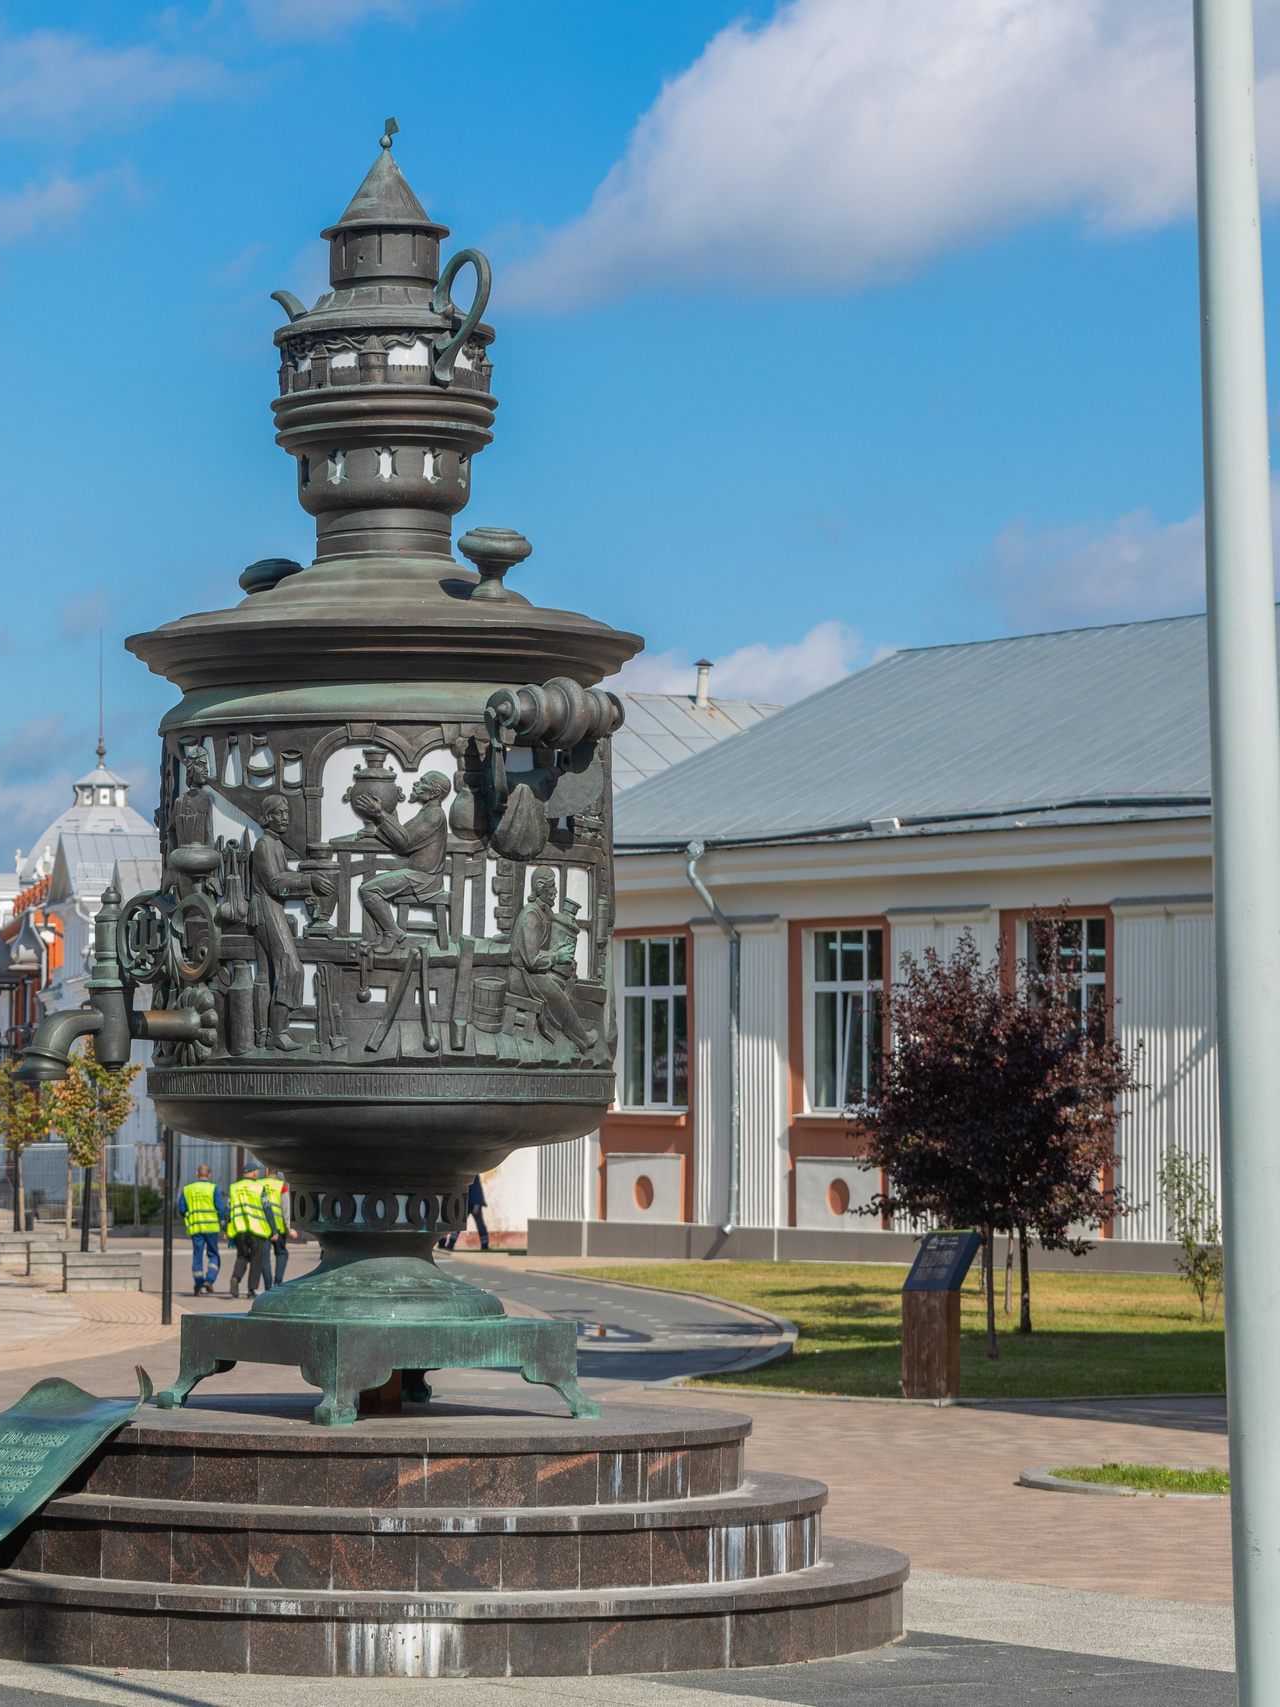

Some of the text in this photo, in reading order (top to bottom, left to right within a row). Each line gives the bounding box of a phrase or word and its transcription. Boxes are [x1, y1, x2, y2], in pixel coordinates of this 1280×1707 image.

[219, 1073, 233, 1096] НА
[235, 1073, 283, 1096] ЛУЧШИЙ
[285, 1073, 325, 1096] ЭСКИЗ
[328, 1074, 408, 1097] ПАМЯТНИКА
